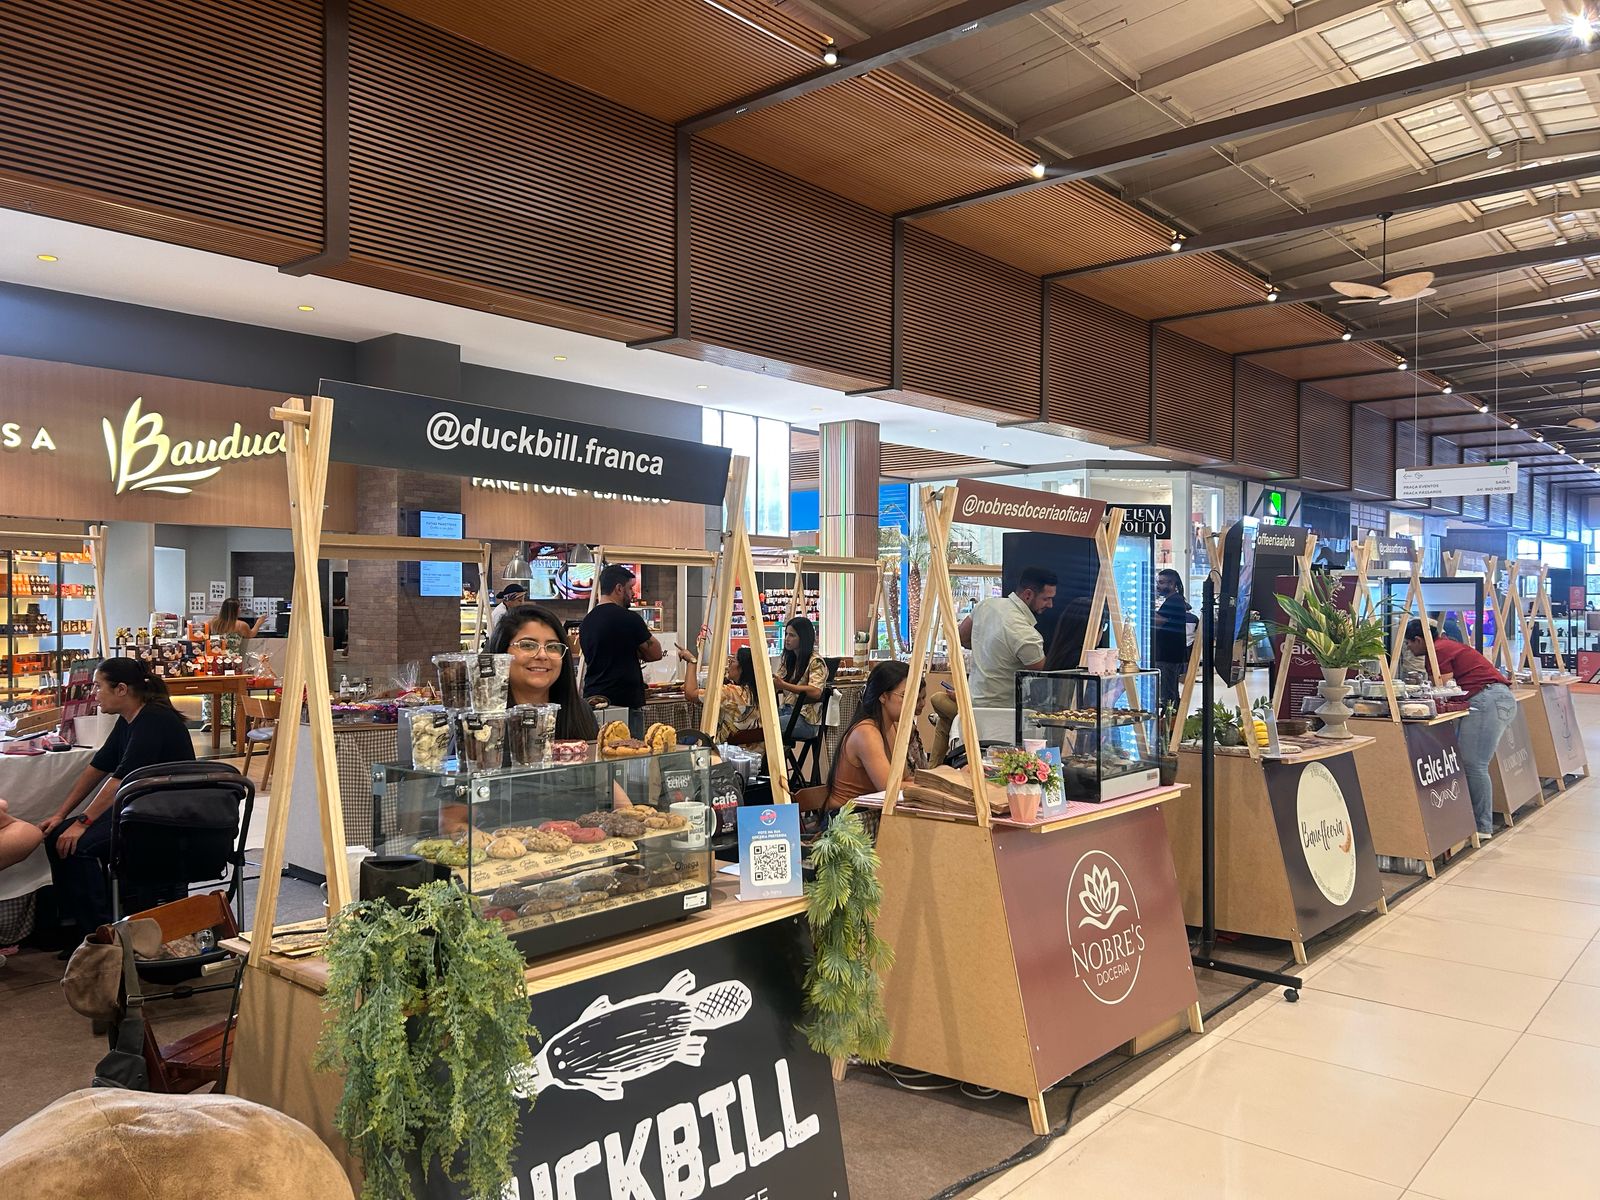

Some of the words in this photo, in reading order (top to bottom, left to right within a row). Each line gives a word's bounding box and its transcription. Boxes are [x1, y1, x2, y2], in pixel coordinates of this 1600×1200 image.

[102, 396, 310, 495] Bauducc
[426, 411, 665, 477] @duckbill.franca
[962, 494, 1092, 524] @nobresdoceriaoficial
[1124, 509, 1166, 522] ELENA
[1121, 521, 1167, 535] OUTO
[1257, 533, 1296, 550] offeeriaalpha
[1280, 641, 1315, 655] Cak
[1417, 755, 1444, 787] Cake
[1442, 745, 1460, 777] Art
[712, 791, 738, 806] café
[1070, 923, 1146, 978] NOBRE'S
[1096, 961, 1131, 986] DOCERIA
